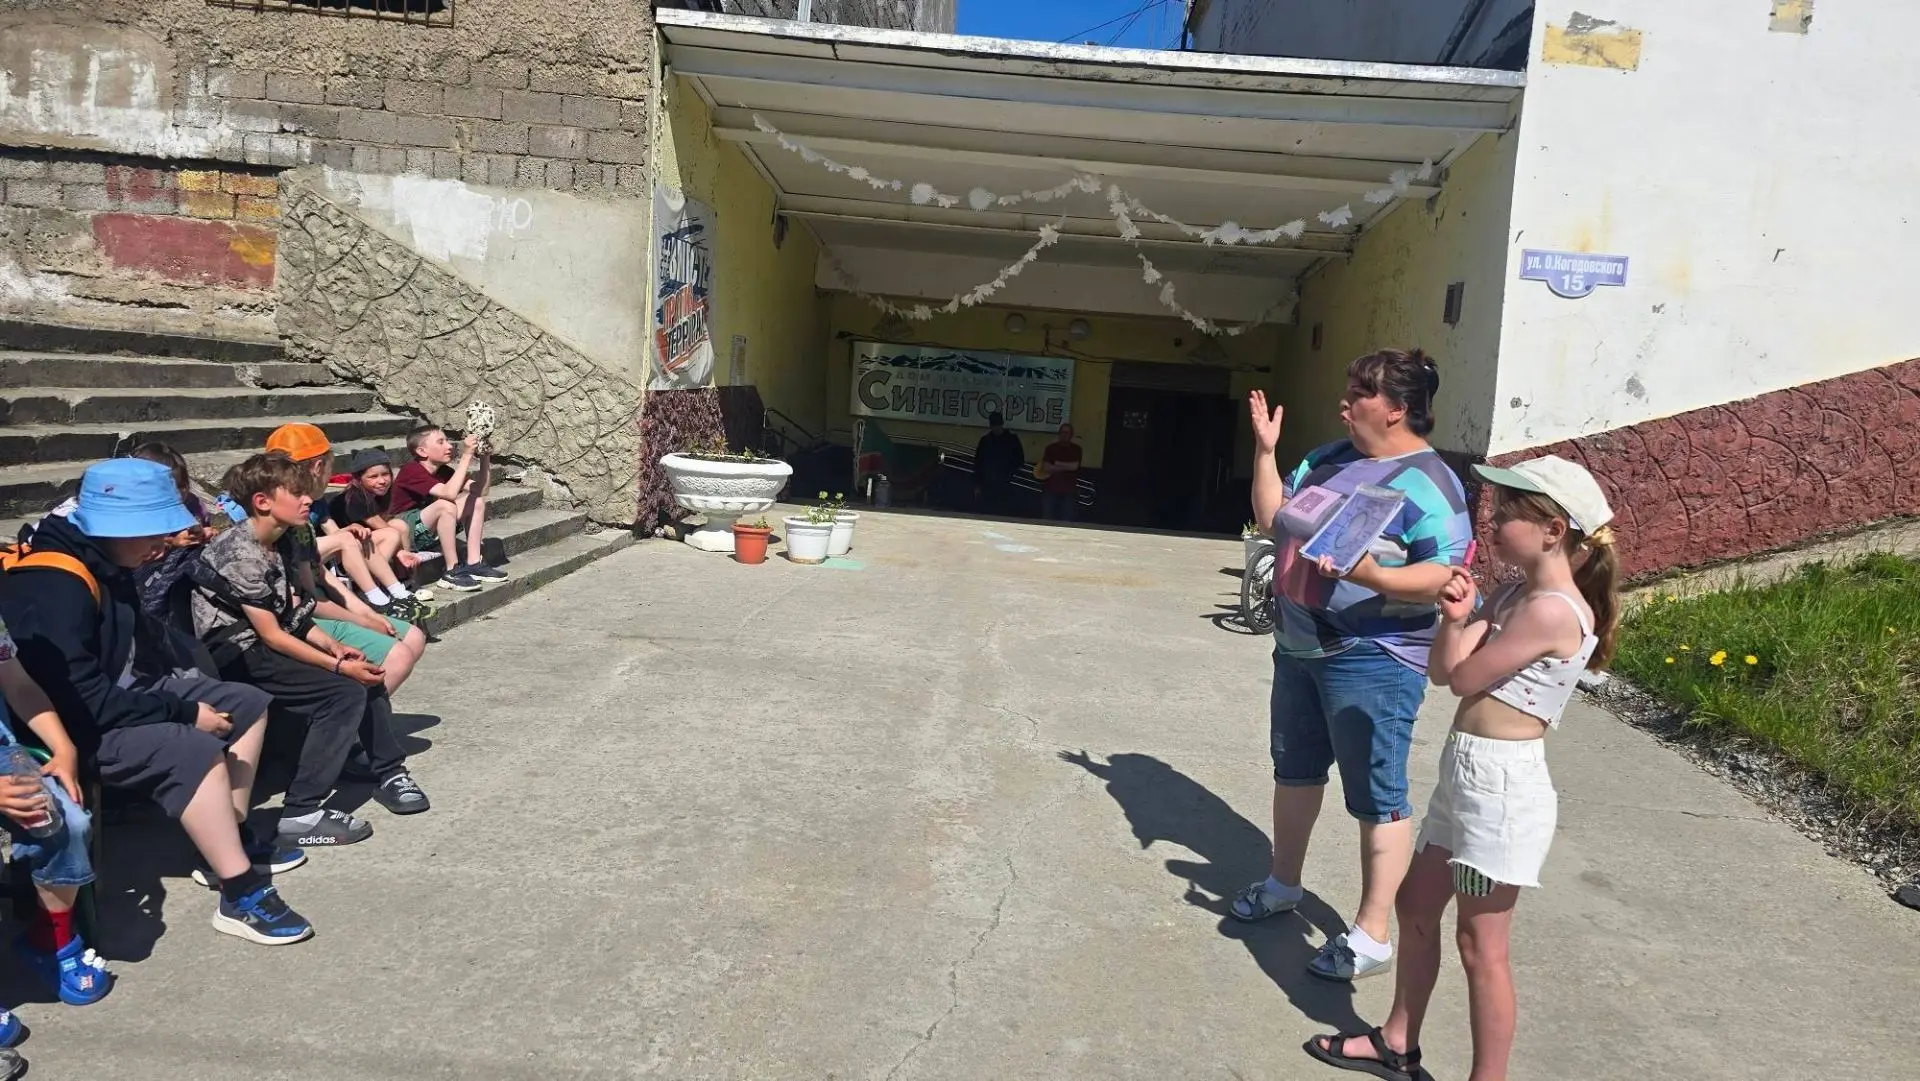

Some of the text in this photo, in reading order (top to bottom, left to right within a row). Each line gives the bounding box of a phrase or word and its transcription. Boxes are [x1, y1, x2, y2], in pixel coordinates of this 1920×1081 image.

[1526, 255, 1542, 271] ул.
[1561, 275, 1585, 291] 15
[858, 369, 1064, 425] СИНЕГОРЬЕ
